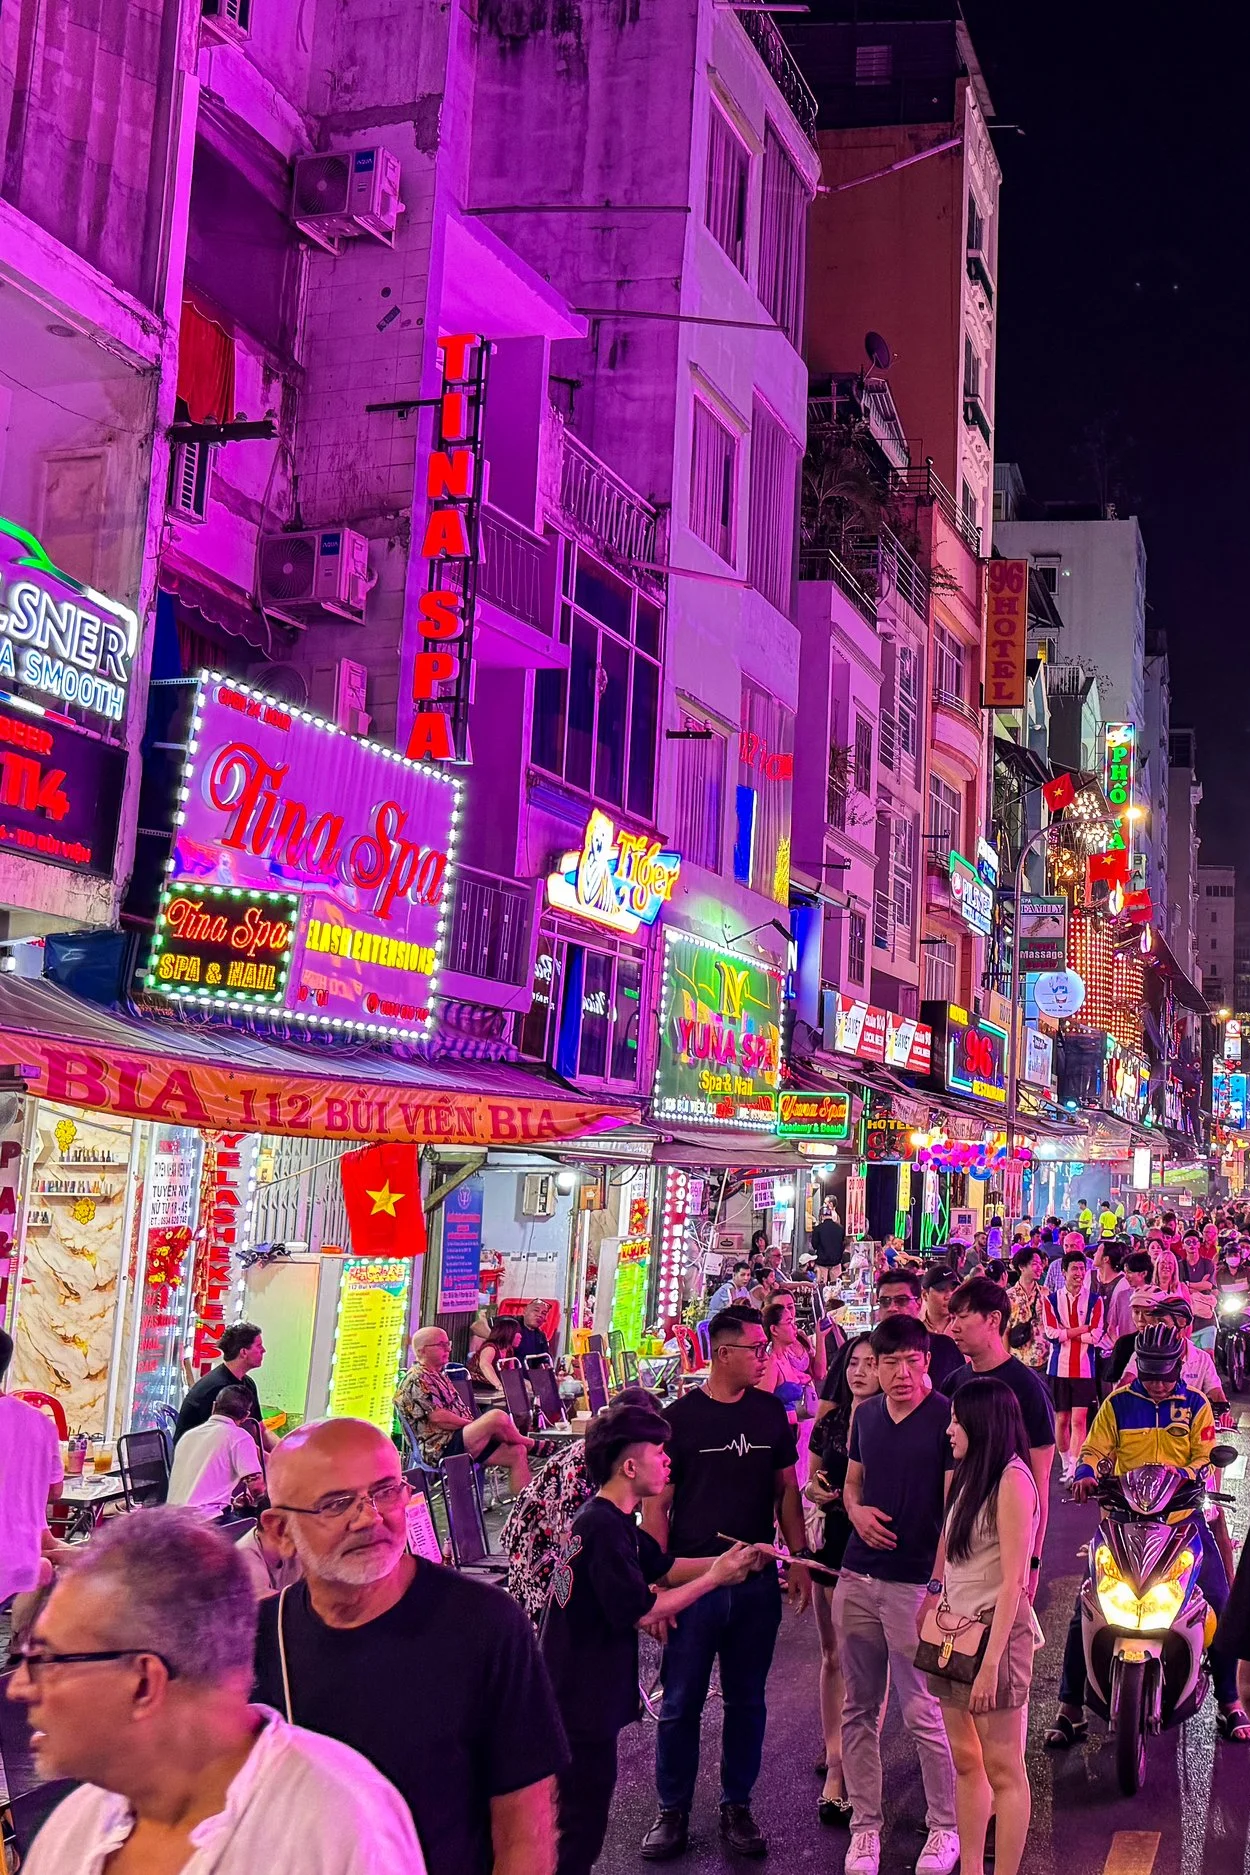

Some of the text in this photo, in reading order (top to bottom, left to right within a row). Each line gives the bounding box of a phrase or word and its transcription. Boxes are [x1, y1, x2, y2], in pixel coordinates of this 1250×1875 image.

[989, 562, 1024, 594] 96
[0, 582, 128, 682] SNER
[991, 596, 1018, 700] HOTEL
[23, 649, 126, 721] SMOOTH
[1109, 746, 1129, 804] PHỐ
[206, 742, 448, 920] Tina Spa
[616, 830, 681, 911] Tiger
[167, 897, 288, 957] Tina Spa
[1021, 904, 1064, 914] FAMILY
[159, 953, 201, 983] SPA
[205, 962, 223, 985] &
[227, 961, 276, 991] NAIL
[1020, 950, 1064, 960] Massage
[949, 1004, 969, 1027] HOTEL
[675, 1016, 737, 1064] YUNA
[965, 1029, 994, 1078] 96
[41, 1049, 214, 1124] BIA
[240, 1088, 313, 1130] 112
[325, 1087, 391, 1135] BÙI
[488, 1104, 558, 1139] BIA
[700, 1070, 724, 1093] Spa
[734, 1076, 754, 1096] Nail
[779, 1122, 812, 1134] Academy
[780, 1095, 819, 1122] Yuna
[819, 1096, 847, 1123] Spa
[867, 1119, 915, 1131] HOTEL
